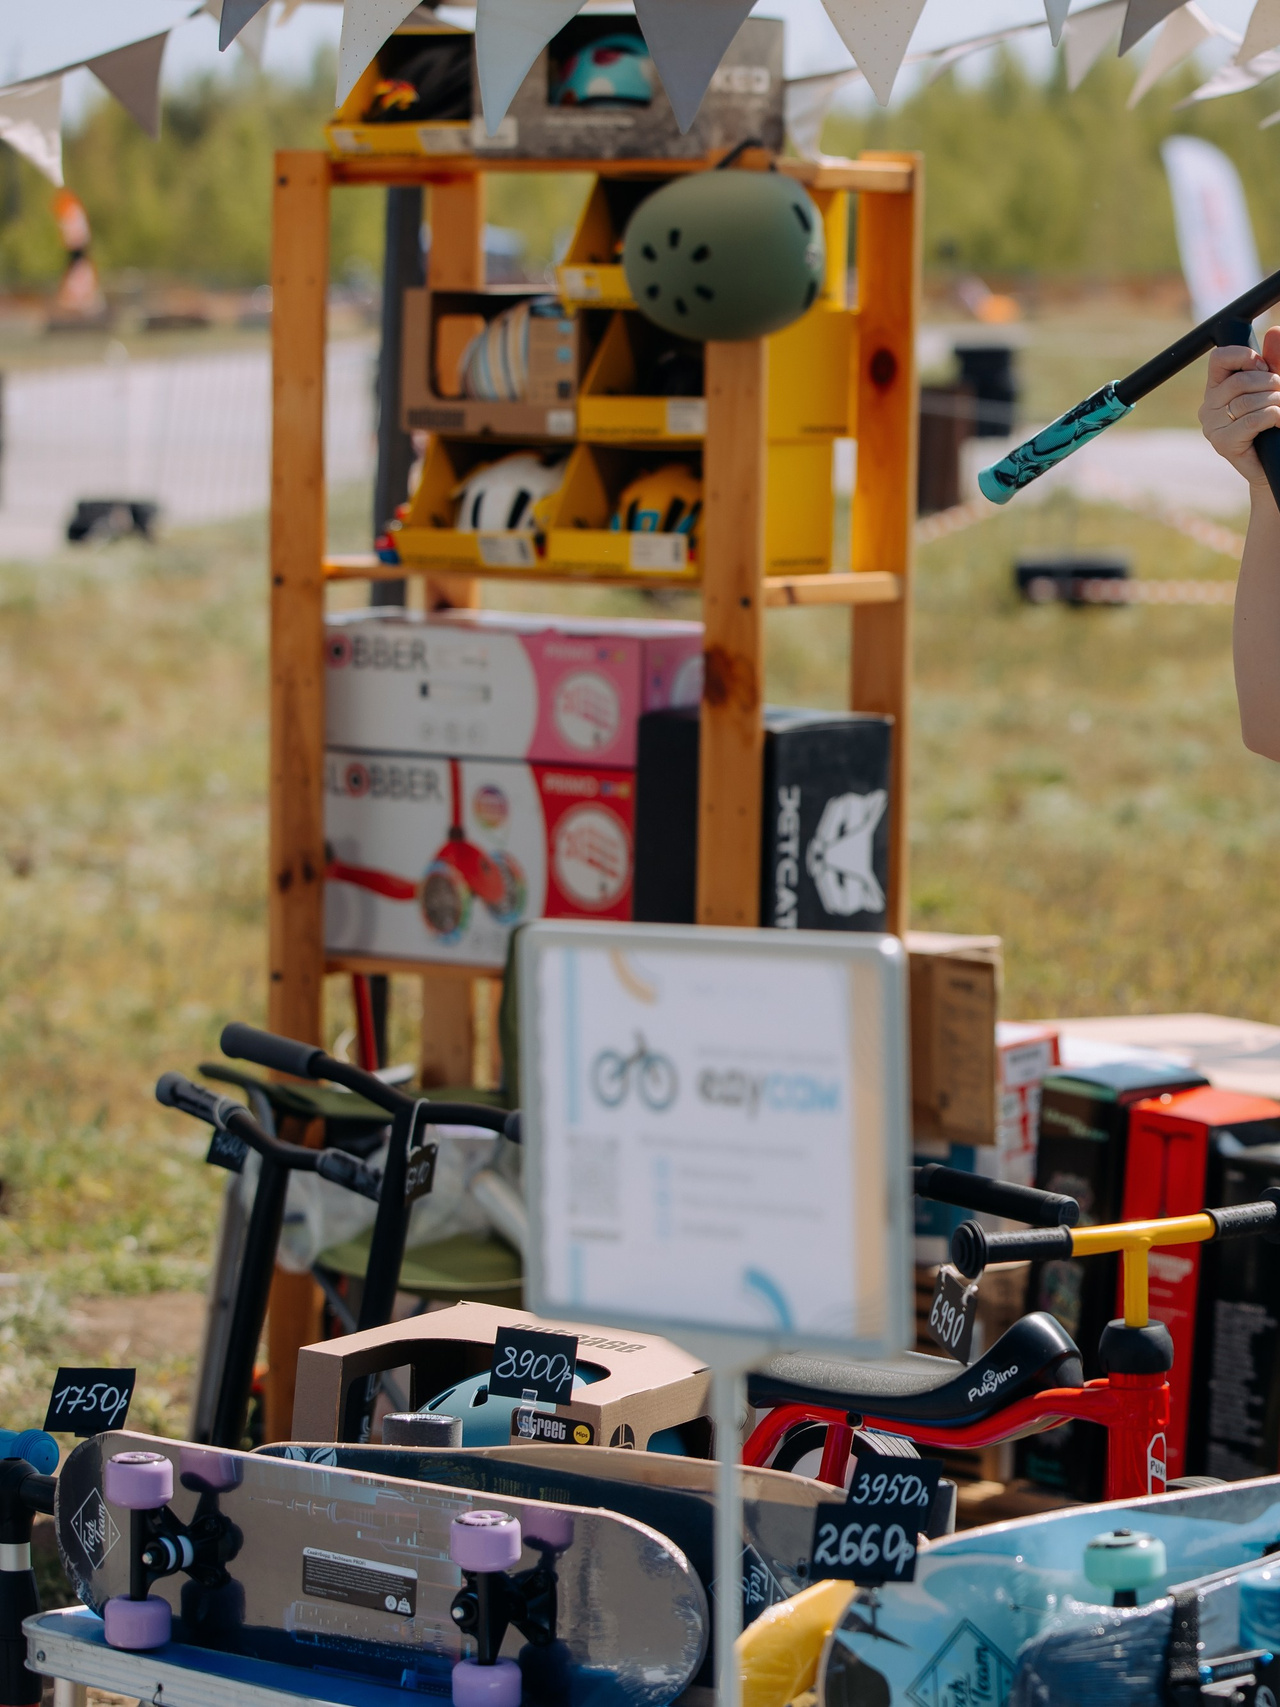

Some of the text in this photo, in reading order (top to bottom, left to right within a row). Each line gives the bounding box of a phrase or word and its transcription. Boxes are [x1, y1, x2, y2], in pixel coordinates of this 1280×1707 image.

[326, 634, 428, 671] OBBER
[329, 762, 442, 799] LOBBER
[930, 1293, 965, 1349] 6990
[967, 1364, 1019, 1402] Pukylino
[521, 1415, 567, 1441] street
[575, 1430, 588, 1440] Mips
